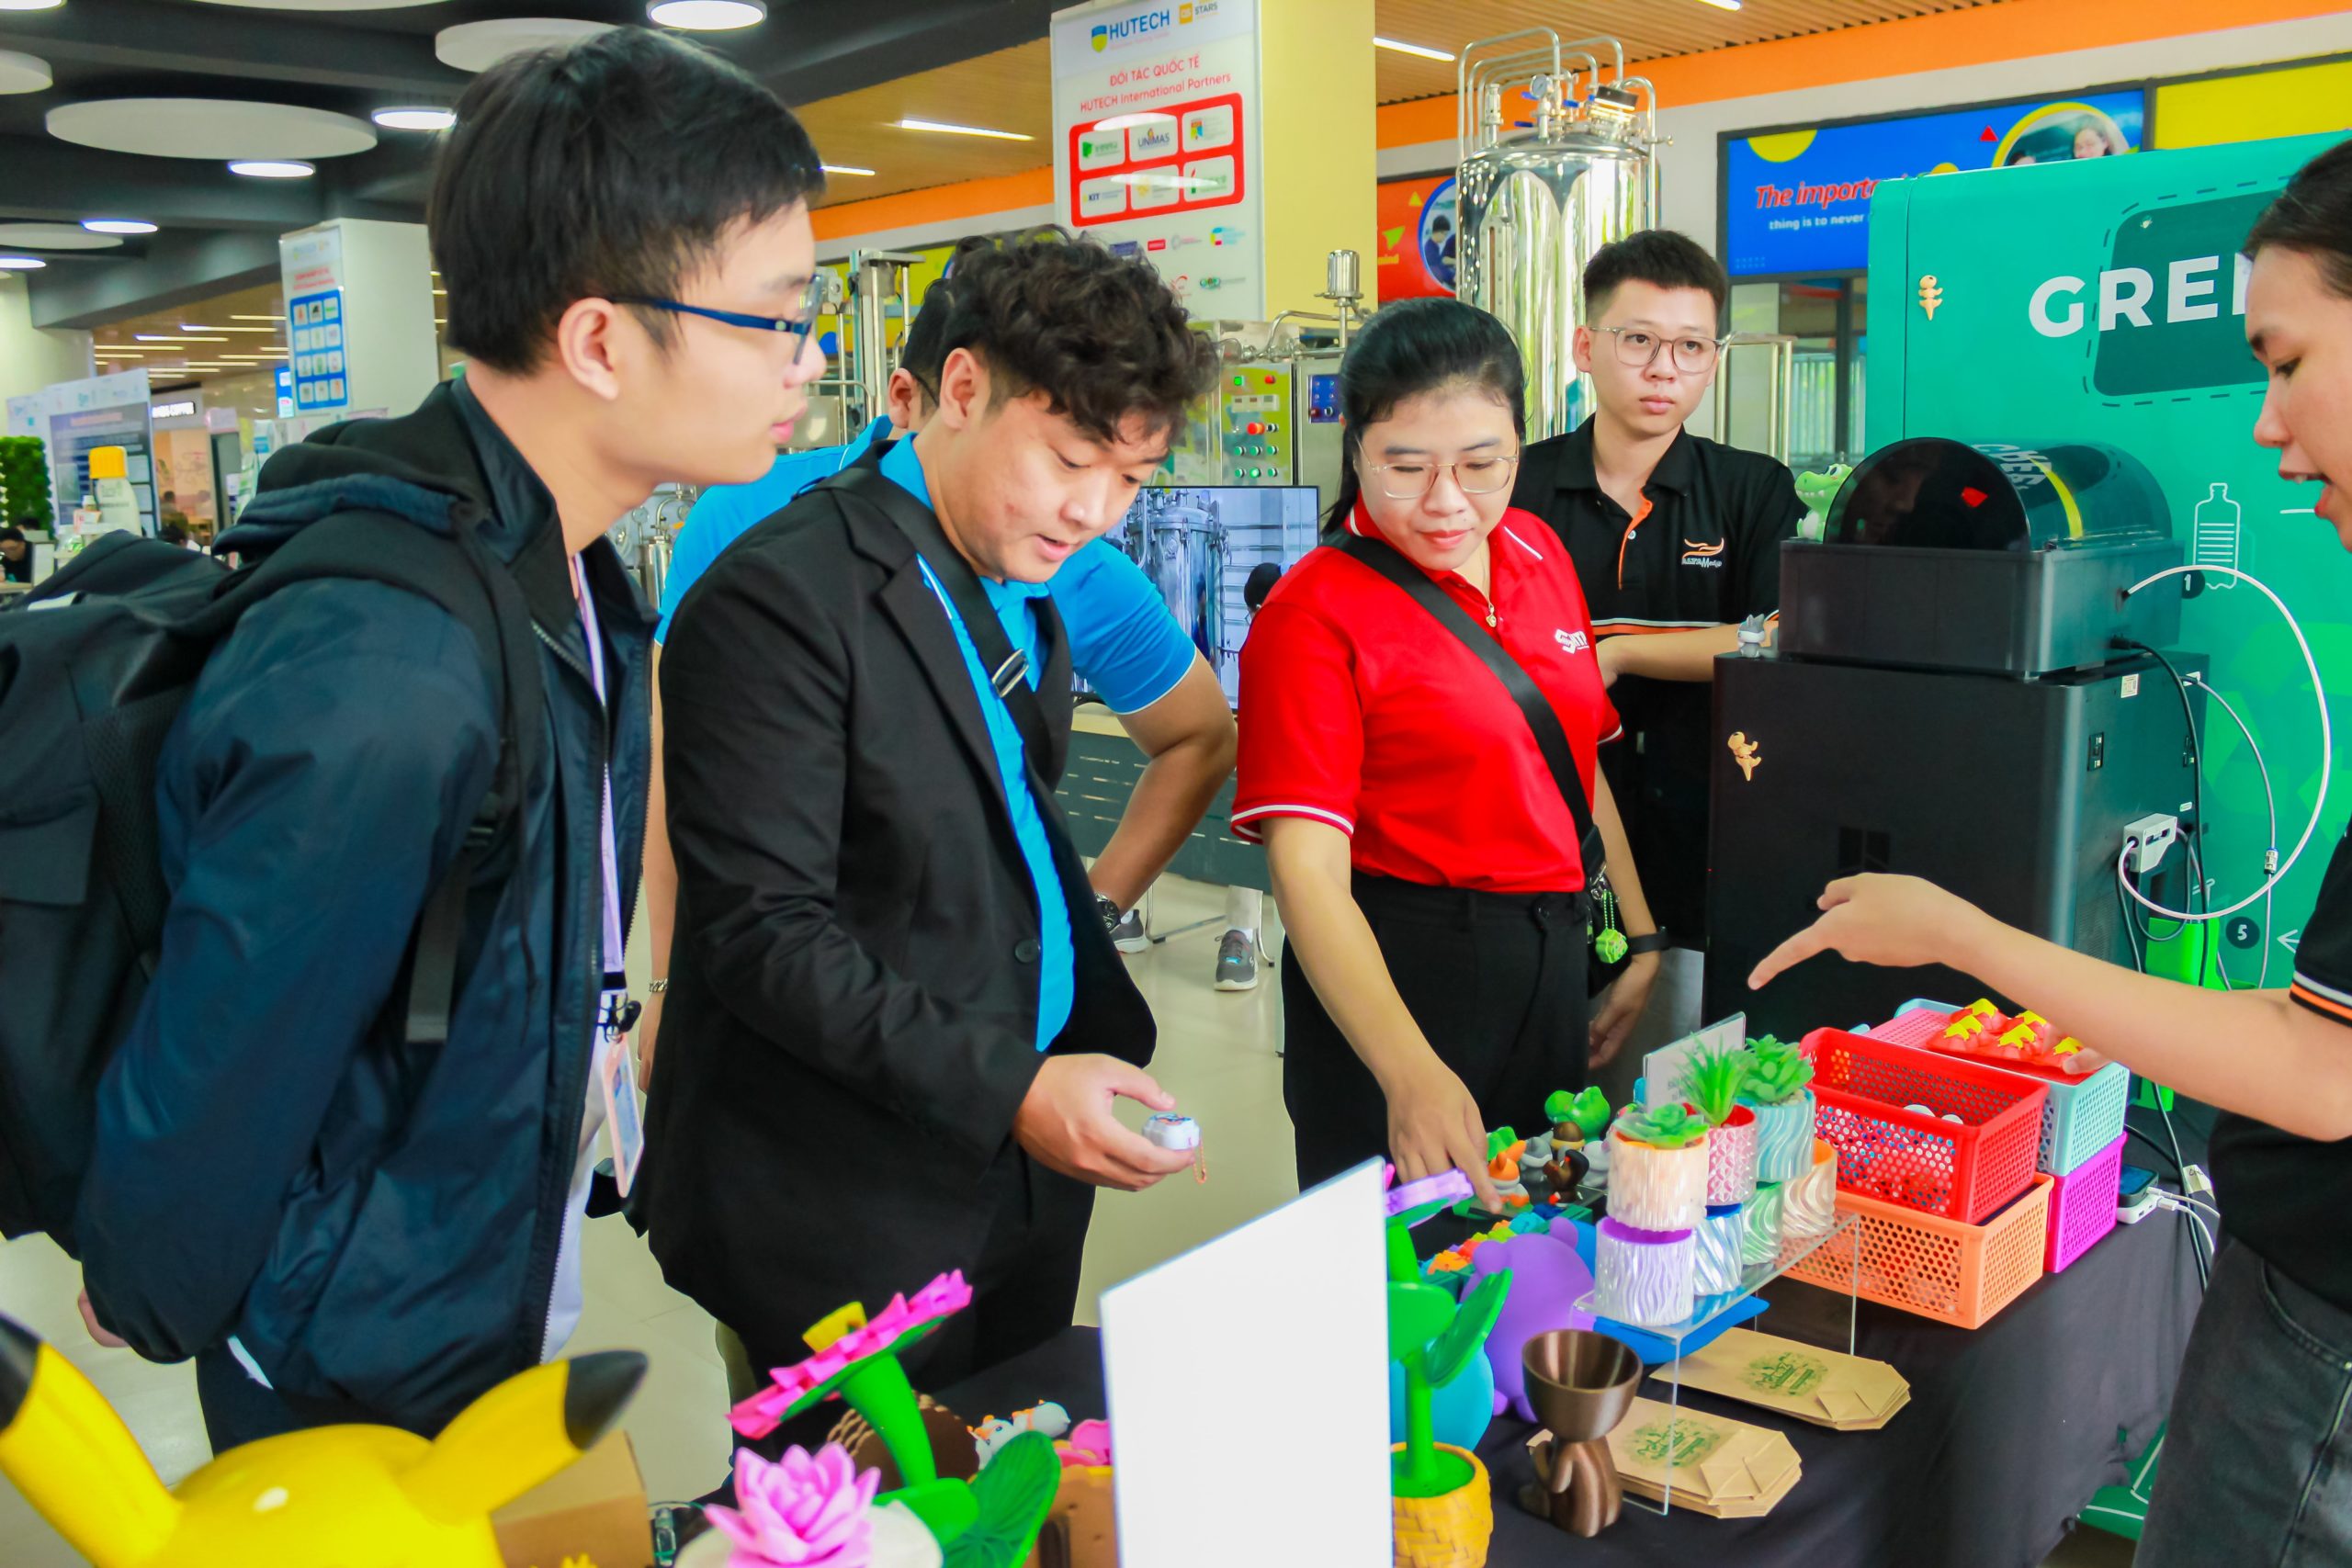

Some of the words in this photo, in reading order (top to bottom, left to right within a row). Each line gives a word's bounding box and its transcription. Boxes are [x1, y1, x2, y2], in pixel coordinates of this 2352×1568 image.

[1194, 2, 1218, 15] STARS
[1110, 9, 1170, 39] HUTECH
[1080, 95, 1117, 112] HUTECH
[1121, 83, 1184, 104] International
[1188, 73, 1231, 91] Partners
[1756, 184, 1792, 209] The
[1770, 218, 1800, 231] thing
[1803, 216, 1812, 227] is
[1815, 217, 1827, 226] to
[1831, 213, 1864, 224] never
[2184, 574, 2191, 591] 1
[2237, 924, 2247, 941] 5
